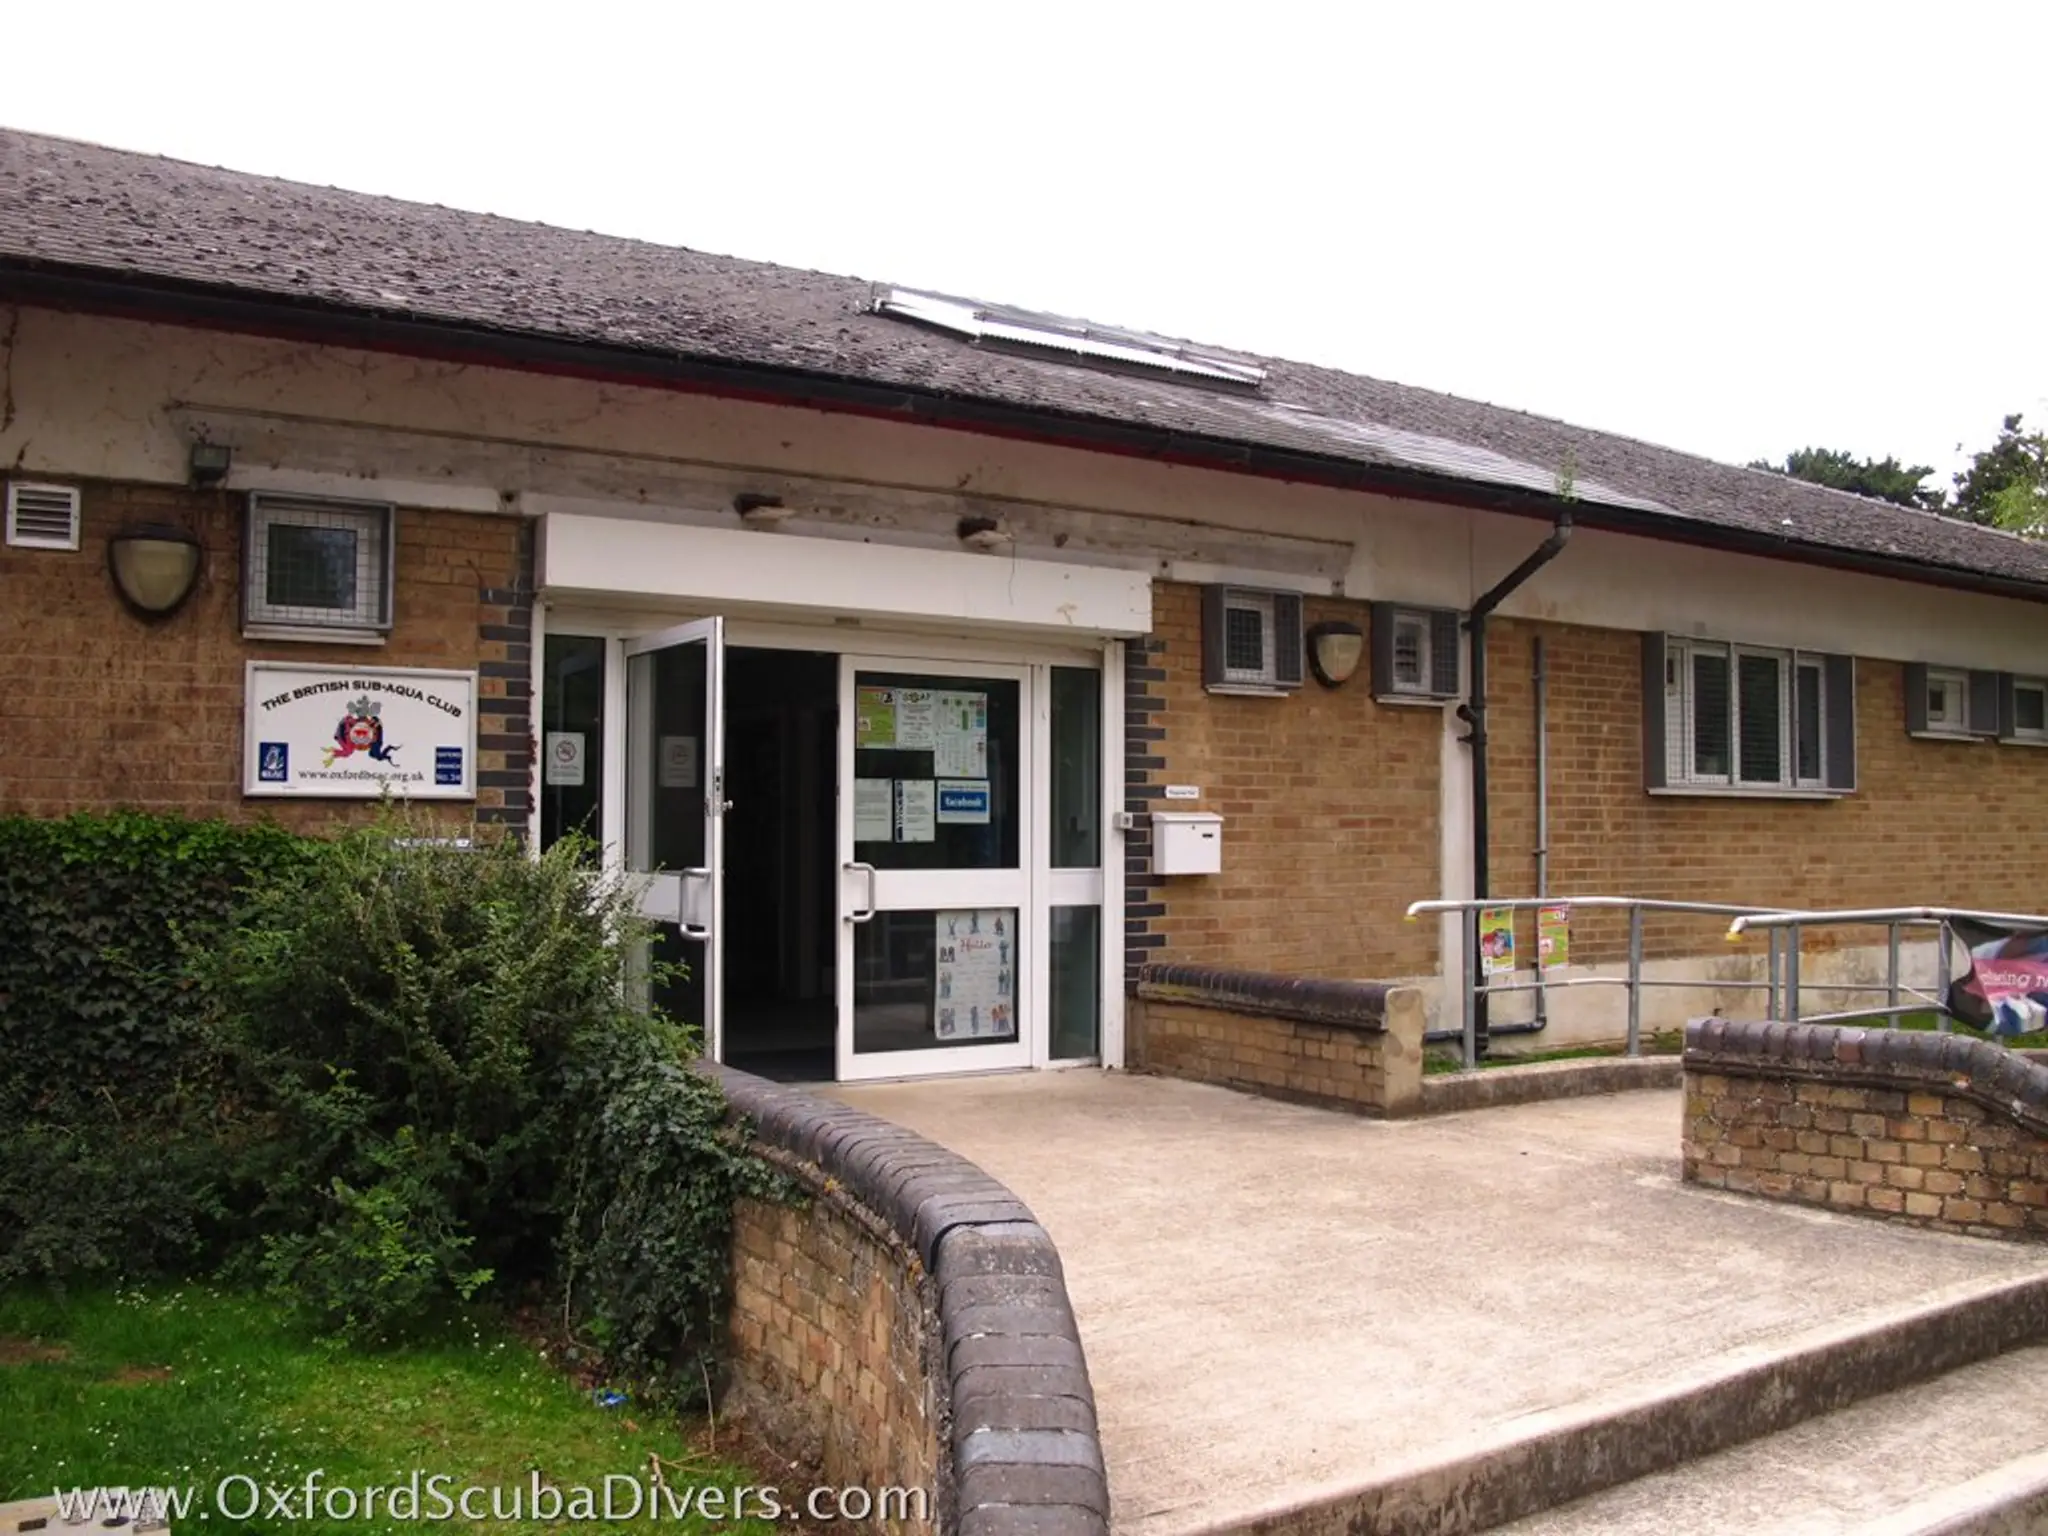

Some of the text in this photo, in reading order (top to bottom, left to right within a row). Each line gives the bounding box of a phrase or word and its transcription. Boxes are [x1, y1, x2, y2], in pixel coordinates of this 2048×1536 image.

[261, 680, 463, 718] THE BRITISH SUB-AQUA CLUB
